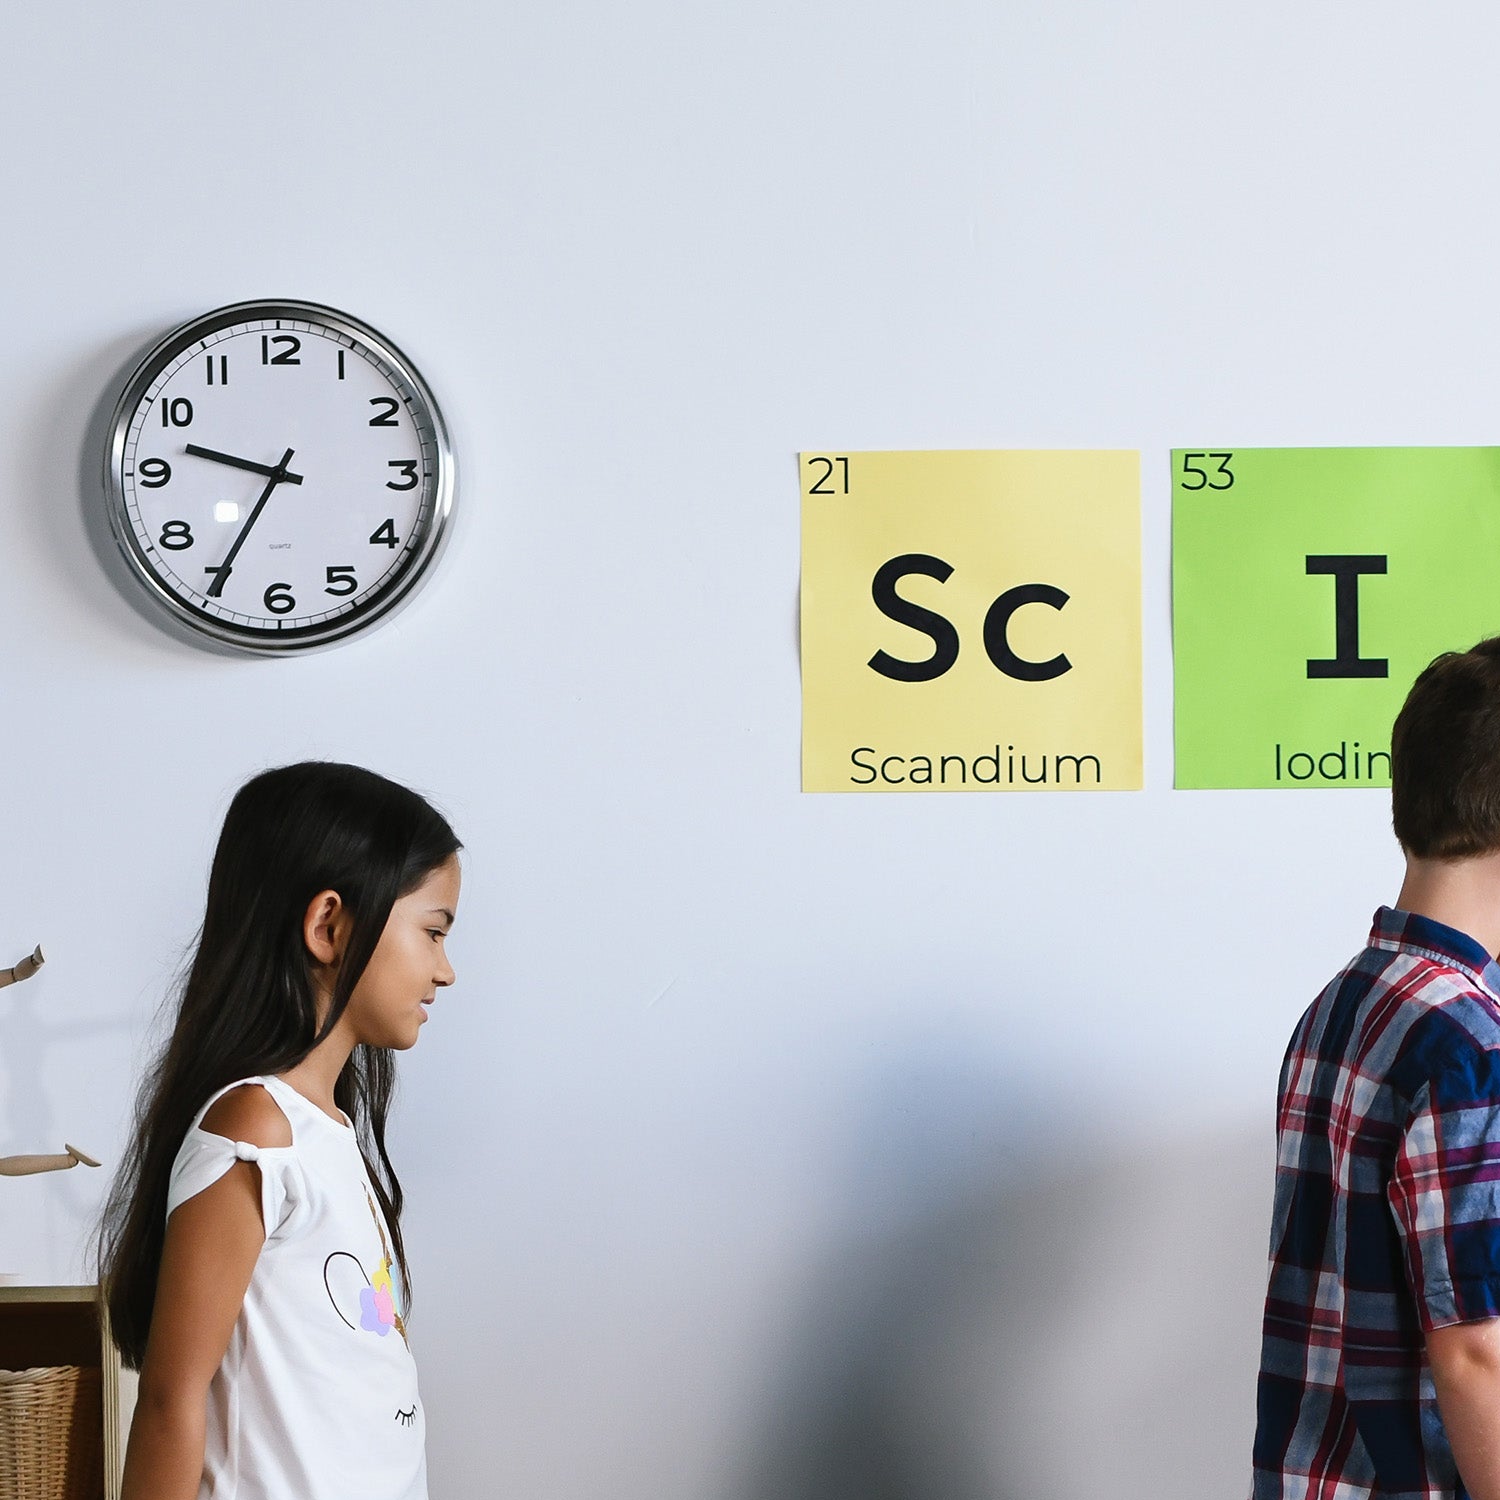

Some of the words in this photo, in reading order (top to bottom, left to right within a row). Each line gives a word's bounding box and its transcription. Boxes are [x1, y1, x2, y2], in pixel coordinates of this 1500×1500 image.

[261, 335, 301, 365] 12
[337, 349, 345, 380] 1
[206, 355, 228, 385] 11
[161, 397, 194, 428] 10
[369, 397, 399, 427] 2
[138, 458, 172, 488] 9
[386, 459, 418, 491] 3
[808, 457, 852, 495] 21
[1180, 453, 1235, 491] 53
[158, 520, 195, 551] 8
[369, 518, 400, 549] 4
[324, 566, 358, 596] 5
[263, 583, 297, 614] 6
[867, 553, 1073, 683] Sc
[1305, 554, 1389, 679] I
[850, 744, 1102, 785] Scandium
[1275, 741, 1392, 780] Iodin
